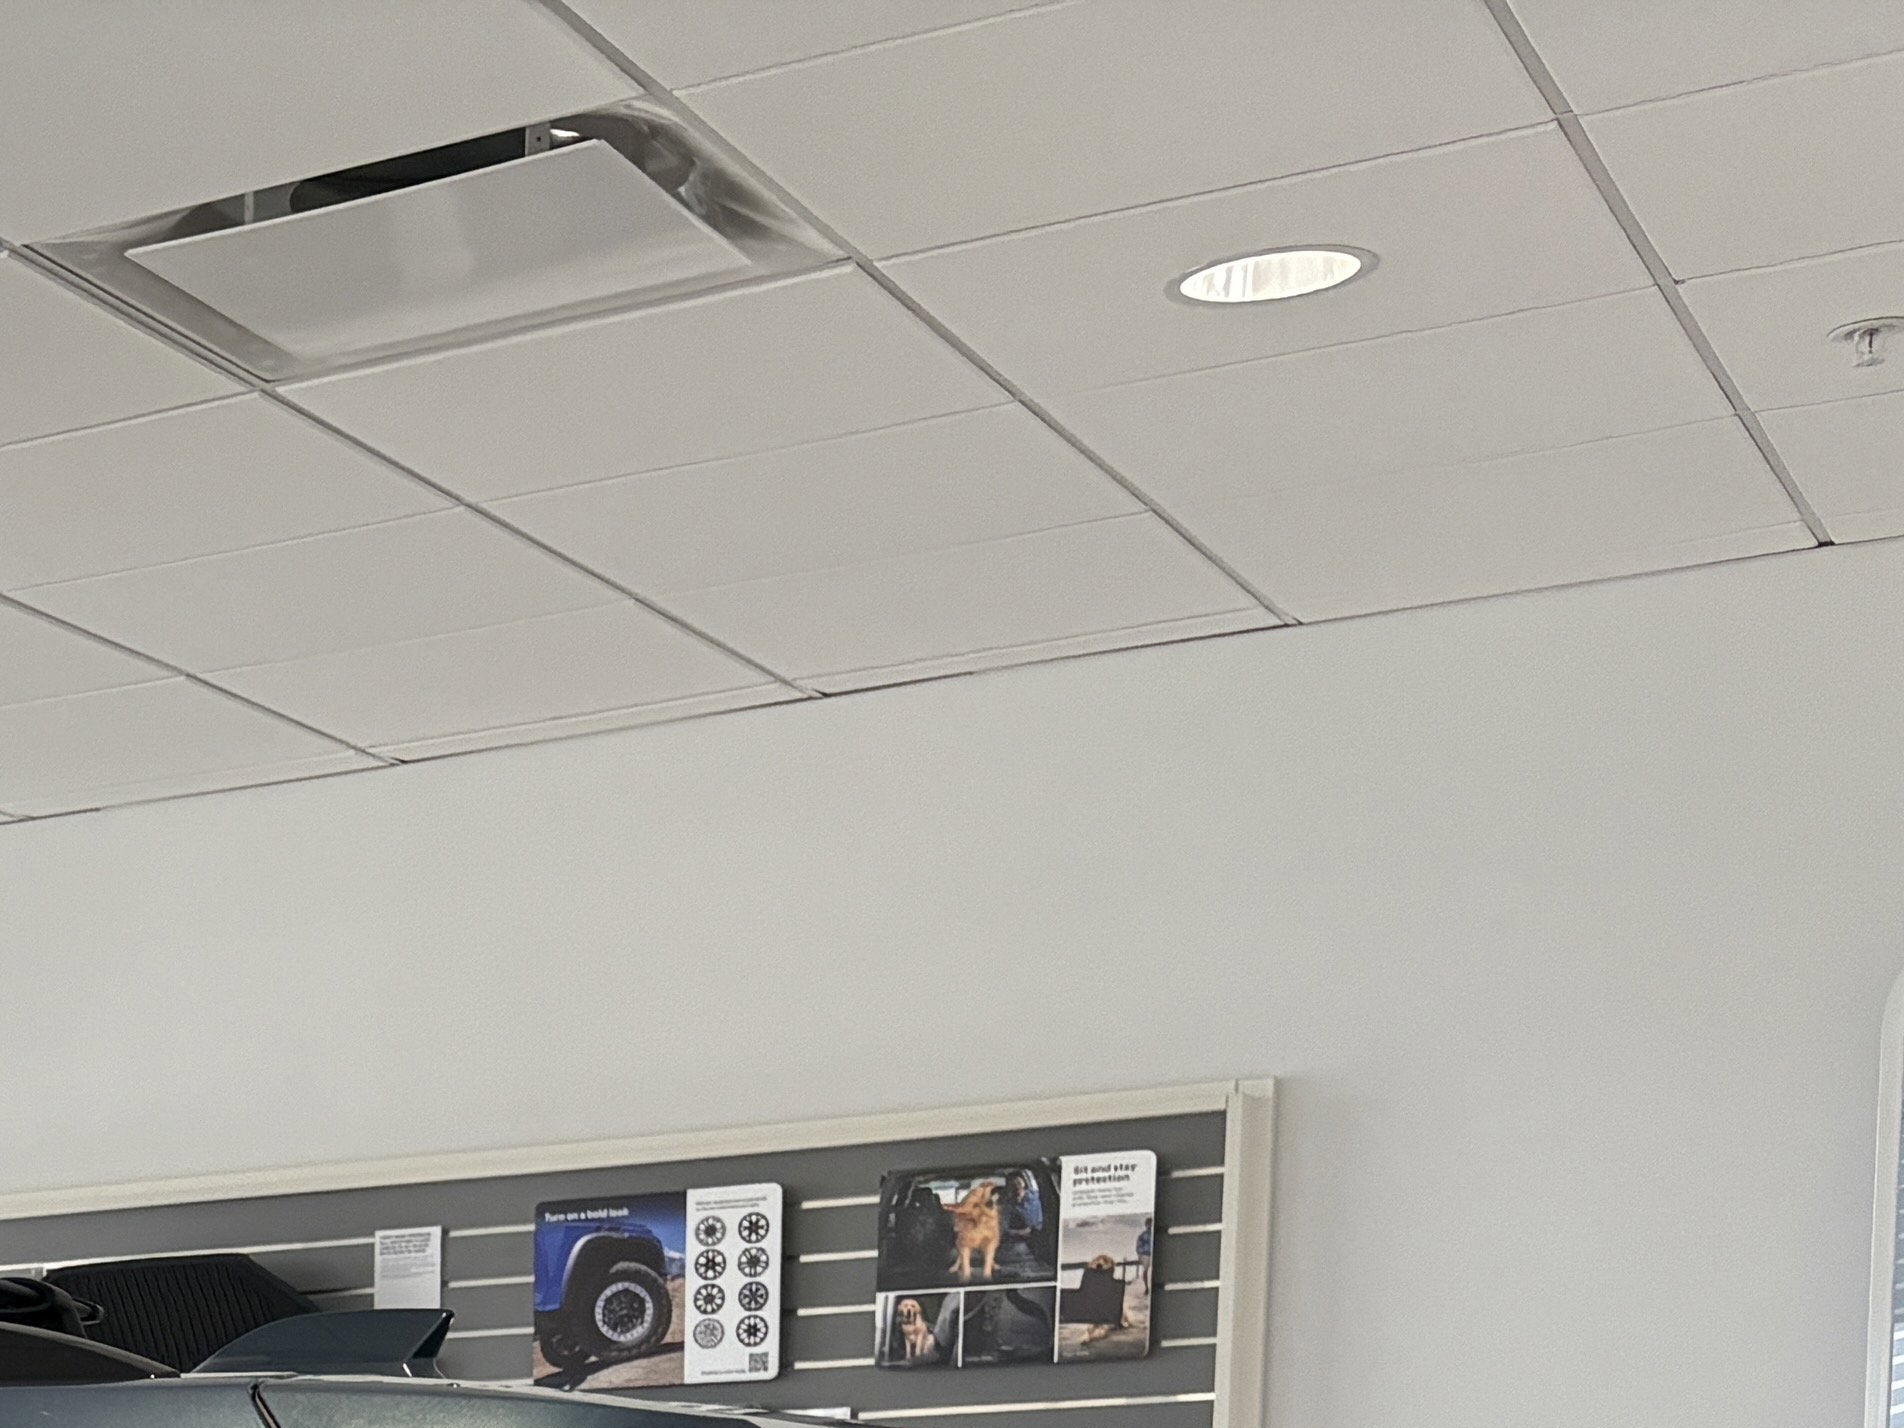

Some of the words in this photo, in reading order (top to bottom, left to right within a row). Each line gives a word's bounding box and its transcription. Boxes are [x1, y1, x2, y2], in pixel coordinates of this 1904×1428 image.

[1091, 1164, 1111, 1174] and
[1073, 1174, 1130, 1187] protection
[567, 1212, 578, 1221] on
[587, 1208, 608, 1219] bold
